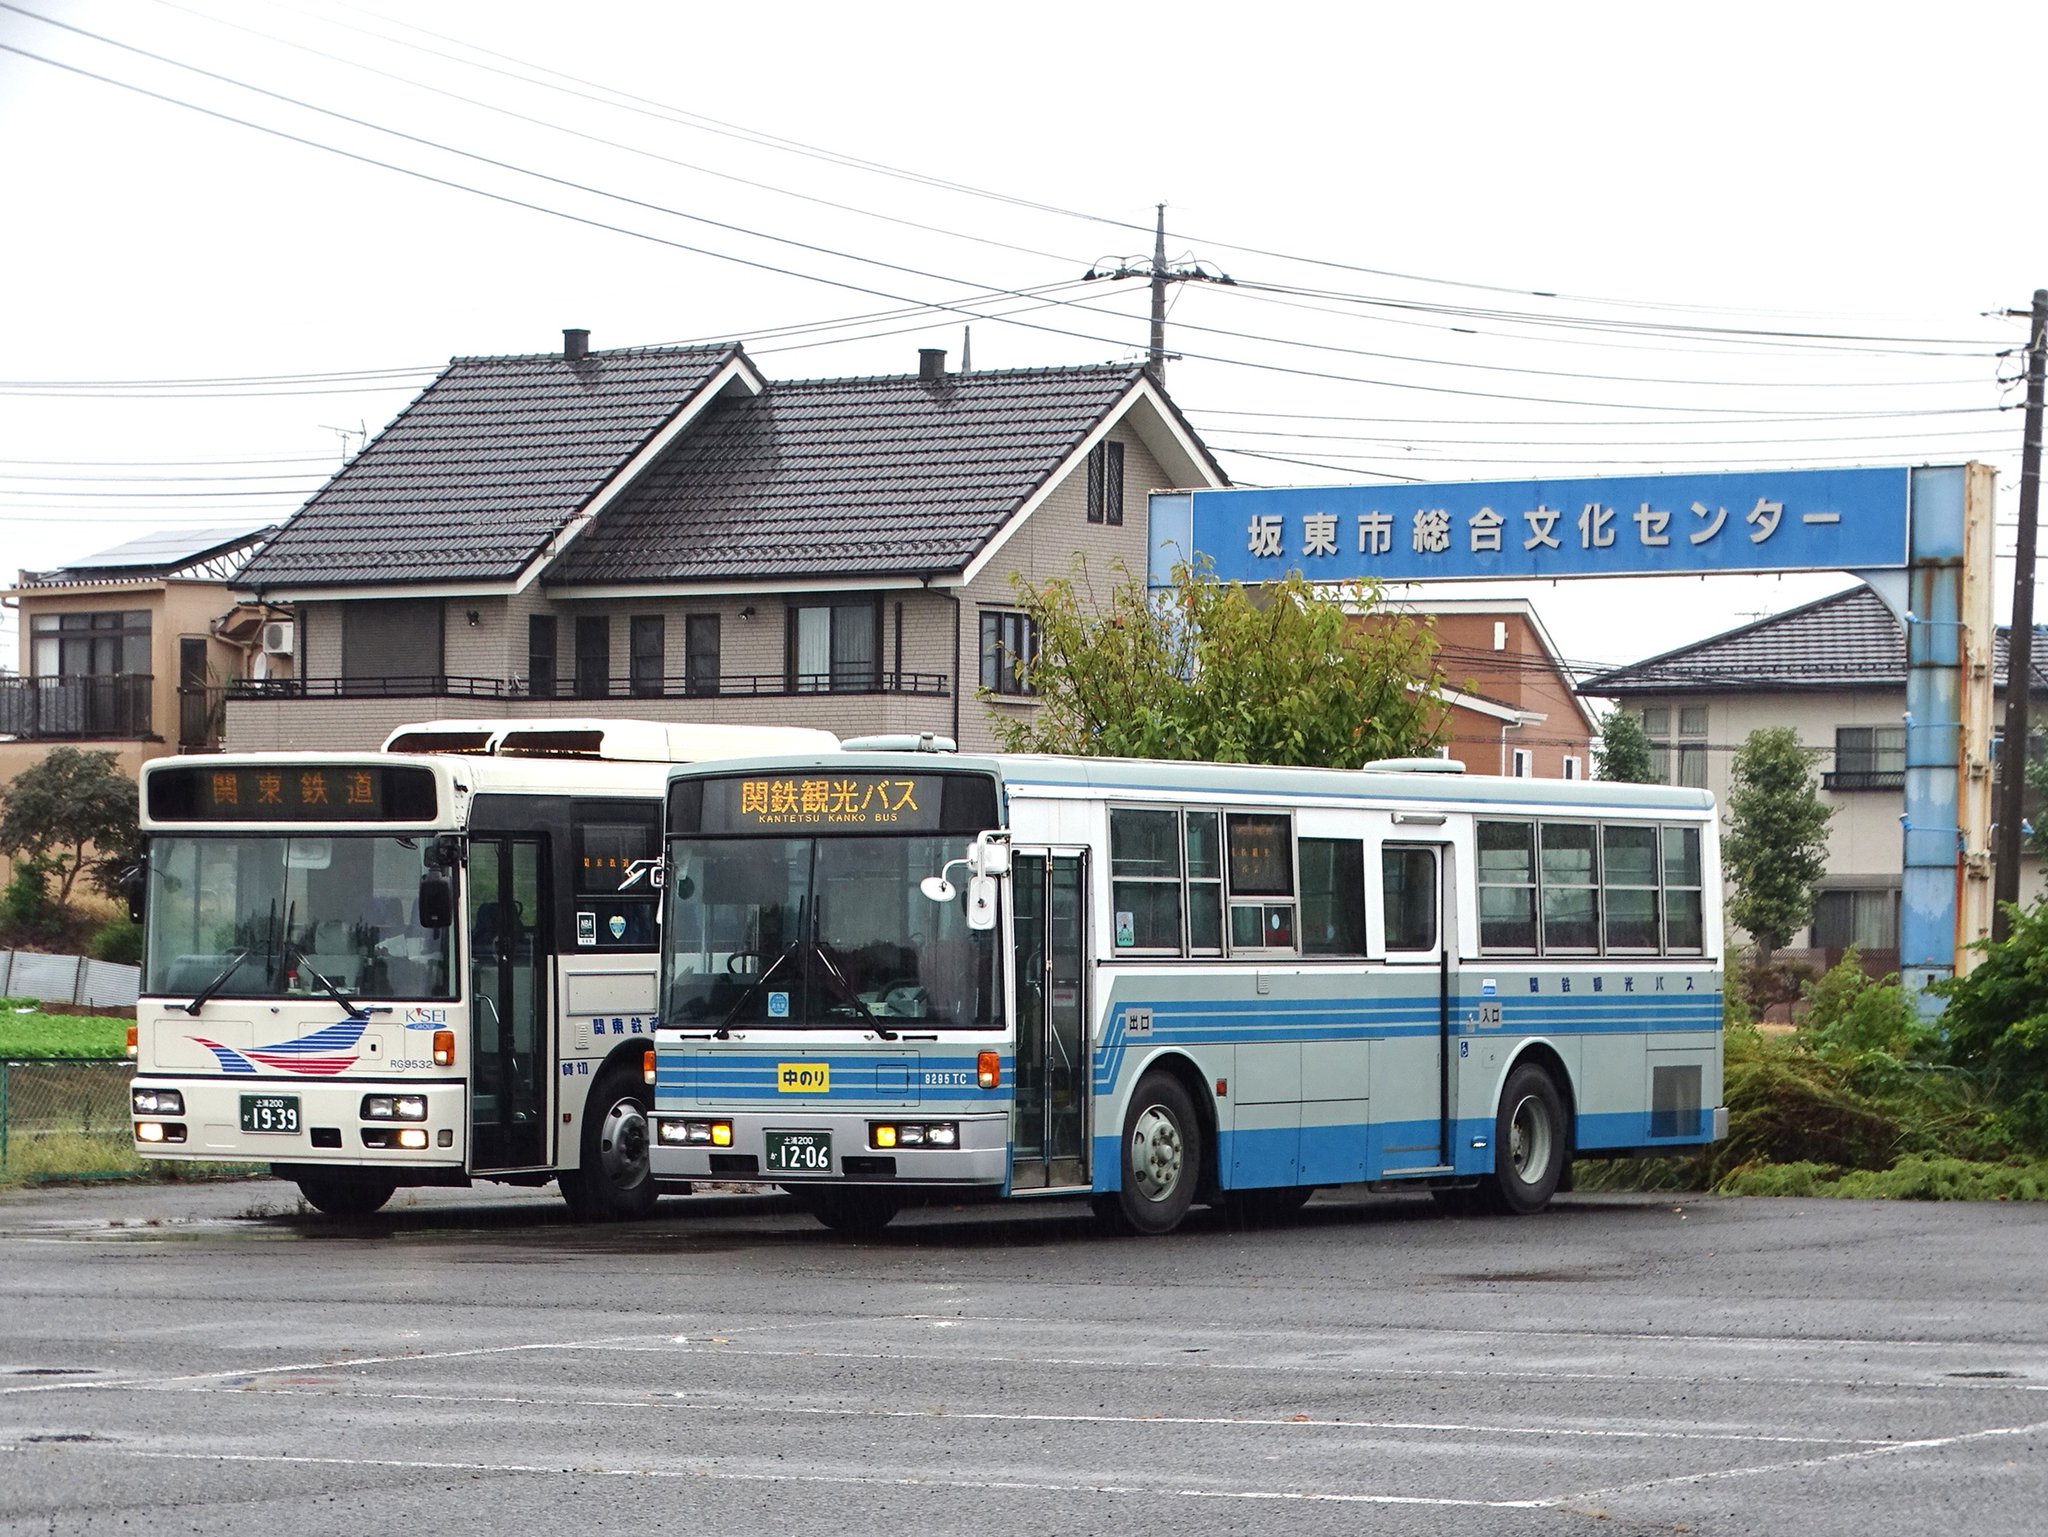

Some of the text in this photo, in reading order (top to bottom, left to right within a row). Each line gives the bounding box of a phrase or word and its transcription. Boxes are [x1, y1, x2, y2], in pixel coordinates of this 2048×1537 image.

[1248, 497, 1841, 559] 坂東市総合文化センター
[211, 772, 374, 805] 関東鉄道
[742, 779, 918, 814] 関鉄観光バス
[759, 813, 898, 823] KANTETSU KANKO BUS
[1529, 976, 1694, 993] 関鉄観光バス
[1129, 1014, 1150, 1031] 出口
[1482, 1008, 1500, 1023] 入口
[390, 1059, 433, 1069] RG9532
[783, 1069, 825, 1087] 中のり
[253, 1107, 298, 1130] 19-39
[780, 1145, 829, 1168] 12-06
